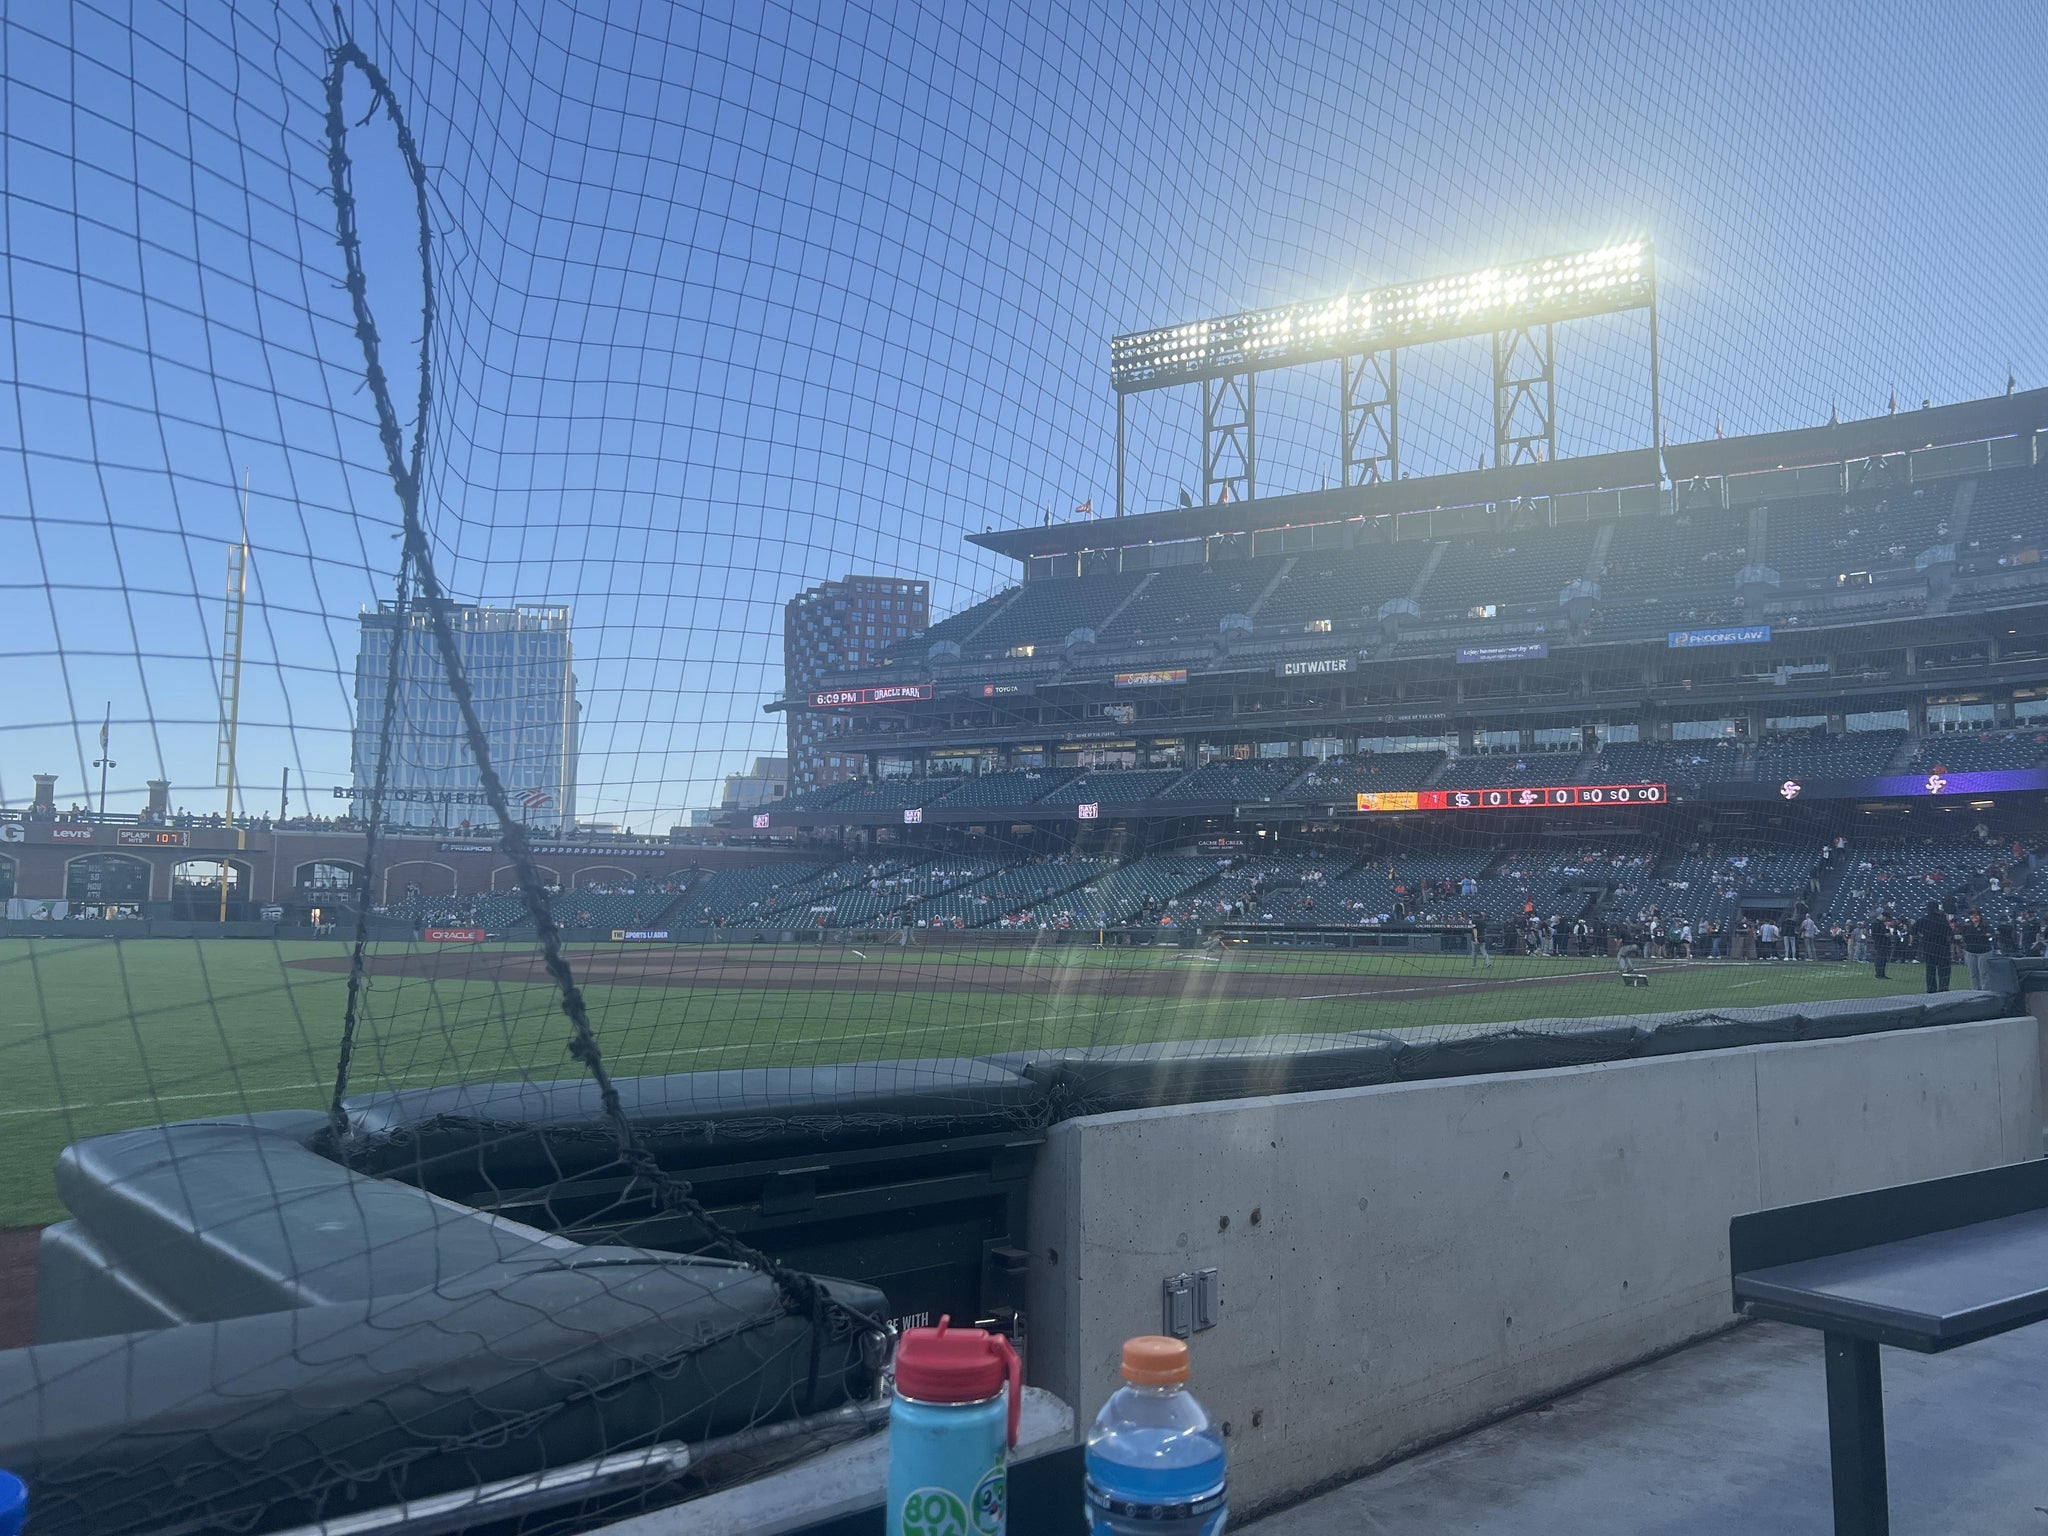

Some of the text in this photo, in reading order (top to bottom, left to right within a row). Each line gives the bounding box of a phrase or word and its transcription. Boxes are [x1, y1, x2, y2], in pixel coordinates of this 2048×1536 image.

[1738, 631, 1763, 640] LAW
[1285, 660, 1347, 675] CUTWATER
[874, 688, 920, 701] ORACLE PARK
[995, 685, 1018, 693] TOYOTA
[817, 693, 857, 704] 6:09 PM
[395, 789, 418, 801] OF
[424, 791, 509, 806] AMERIA
[1489, 792, 1501, 805] 0
[1556, 790, 1567, 804] 0
[121, 831, 150, 839] SPLASH
[156, 833, 177, 843] 107
[625, 931, 646, 939] SPORTS
[902, 1311, 929, 1331] WITH
